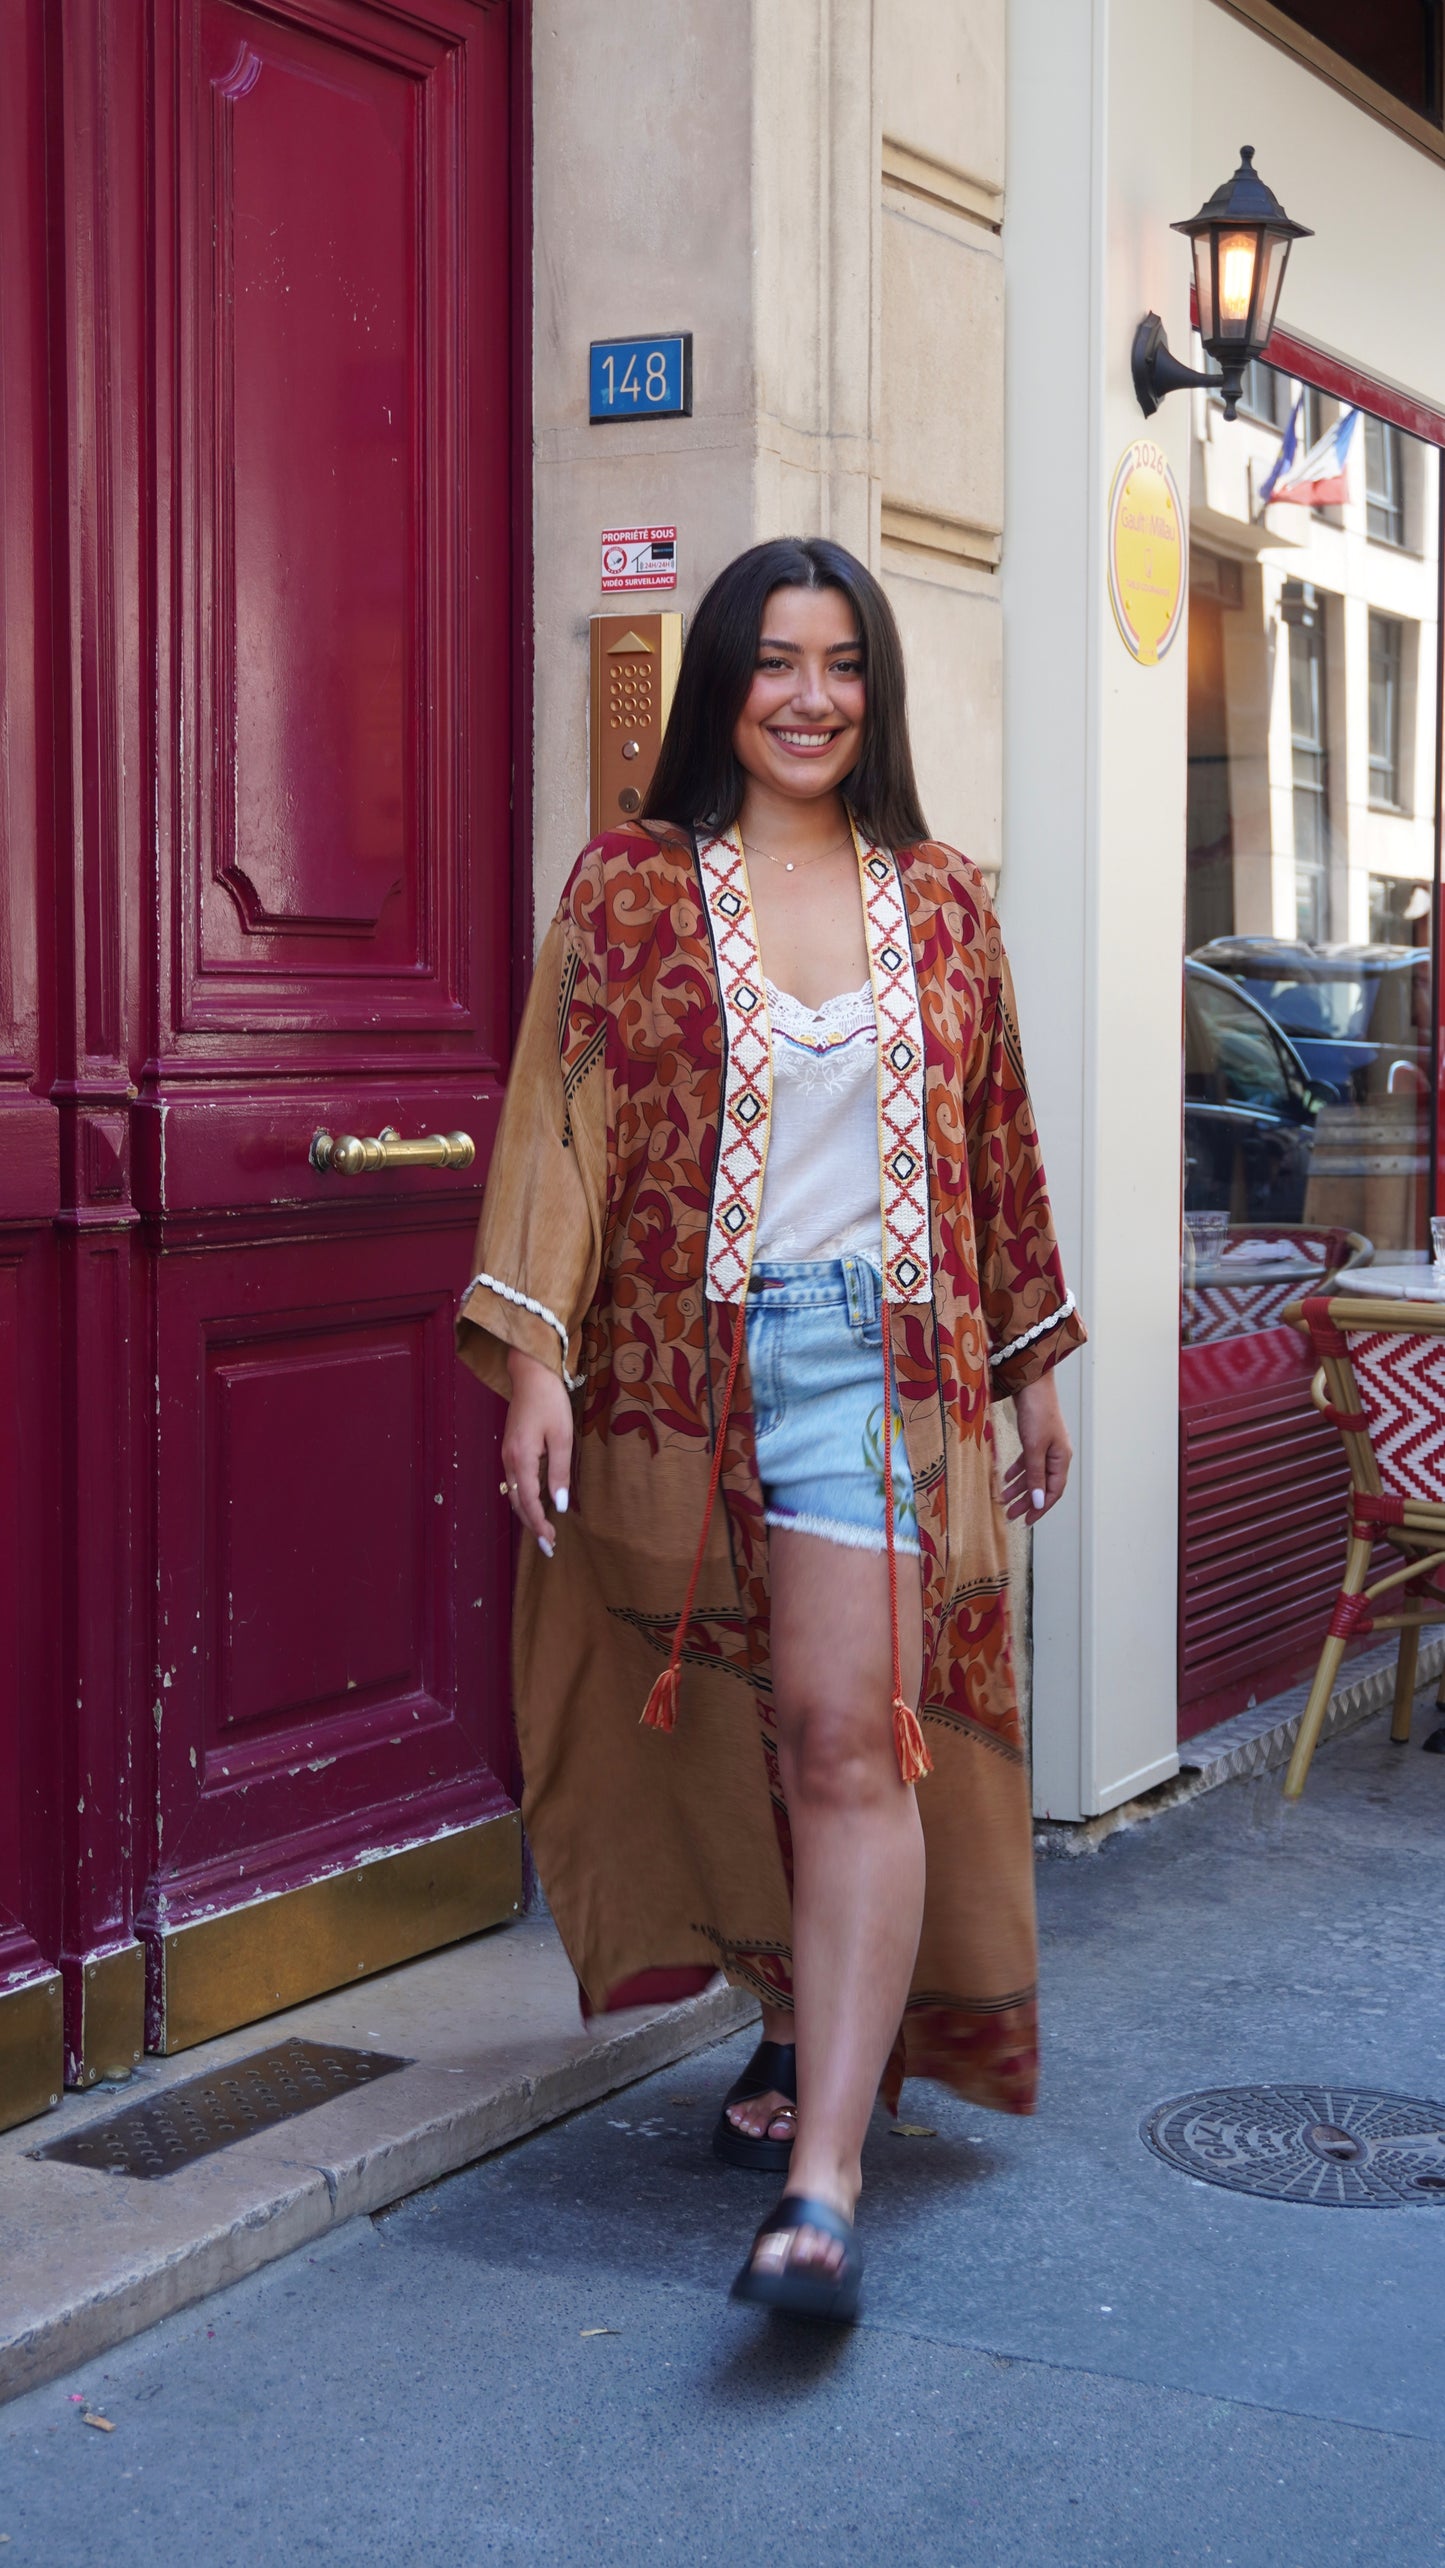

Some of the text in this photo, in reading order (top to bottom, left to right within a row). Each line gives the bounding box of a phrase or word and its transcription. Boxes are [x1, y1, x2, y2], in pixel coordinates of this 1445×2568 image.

[602, 352, 666, 405] 148
[1134, 443, 1164, 477] 2026
[602, 528, 674, 542] PROPRIÉTÉ SOUS
[602, 576, 674, 588] VIDÉO SURVEILLANCE
[1192, 2124, 1237, 2159] GAZ
